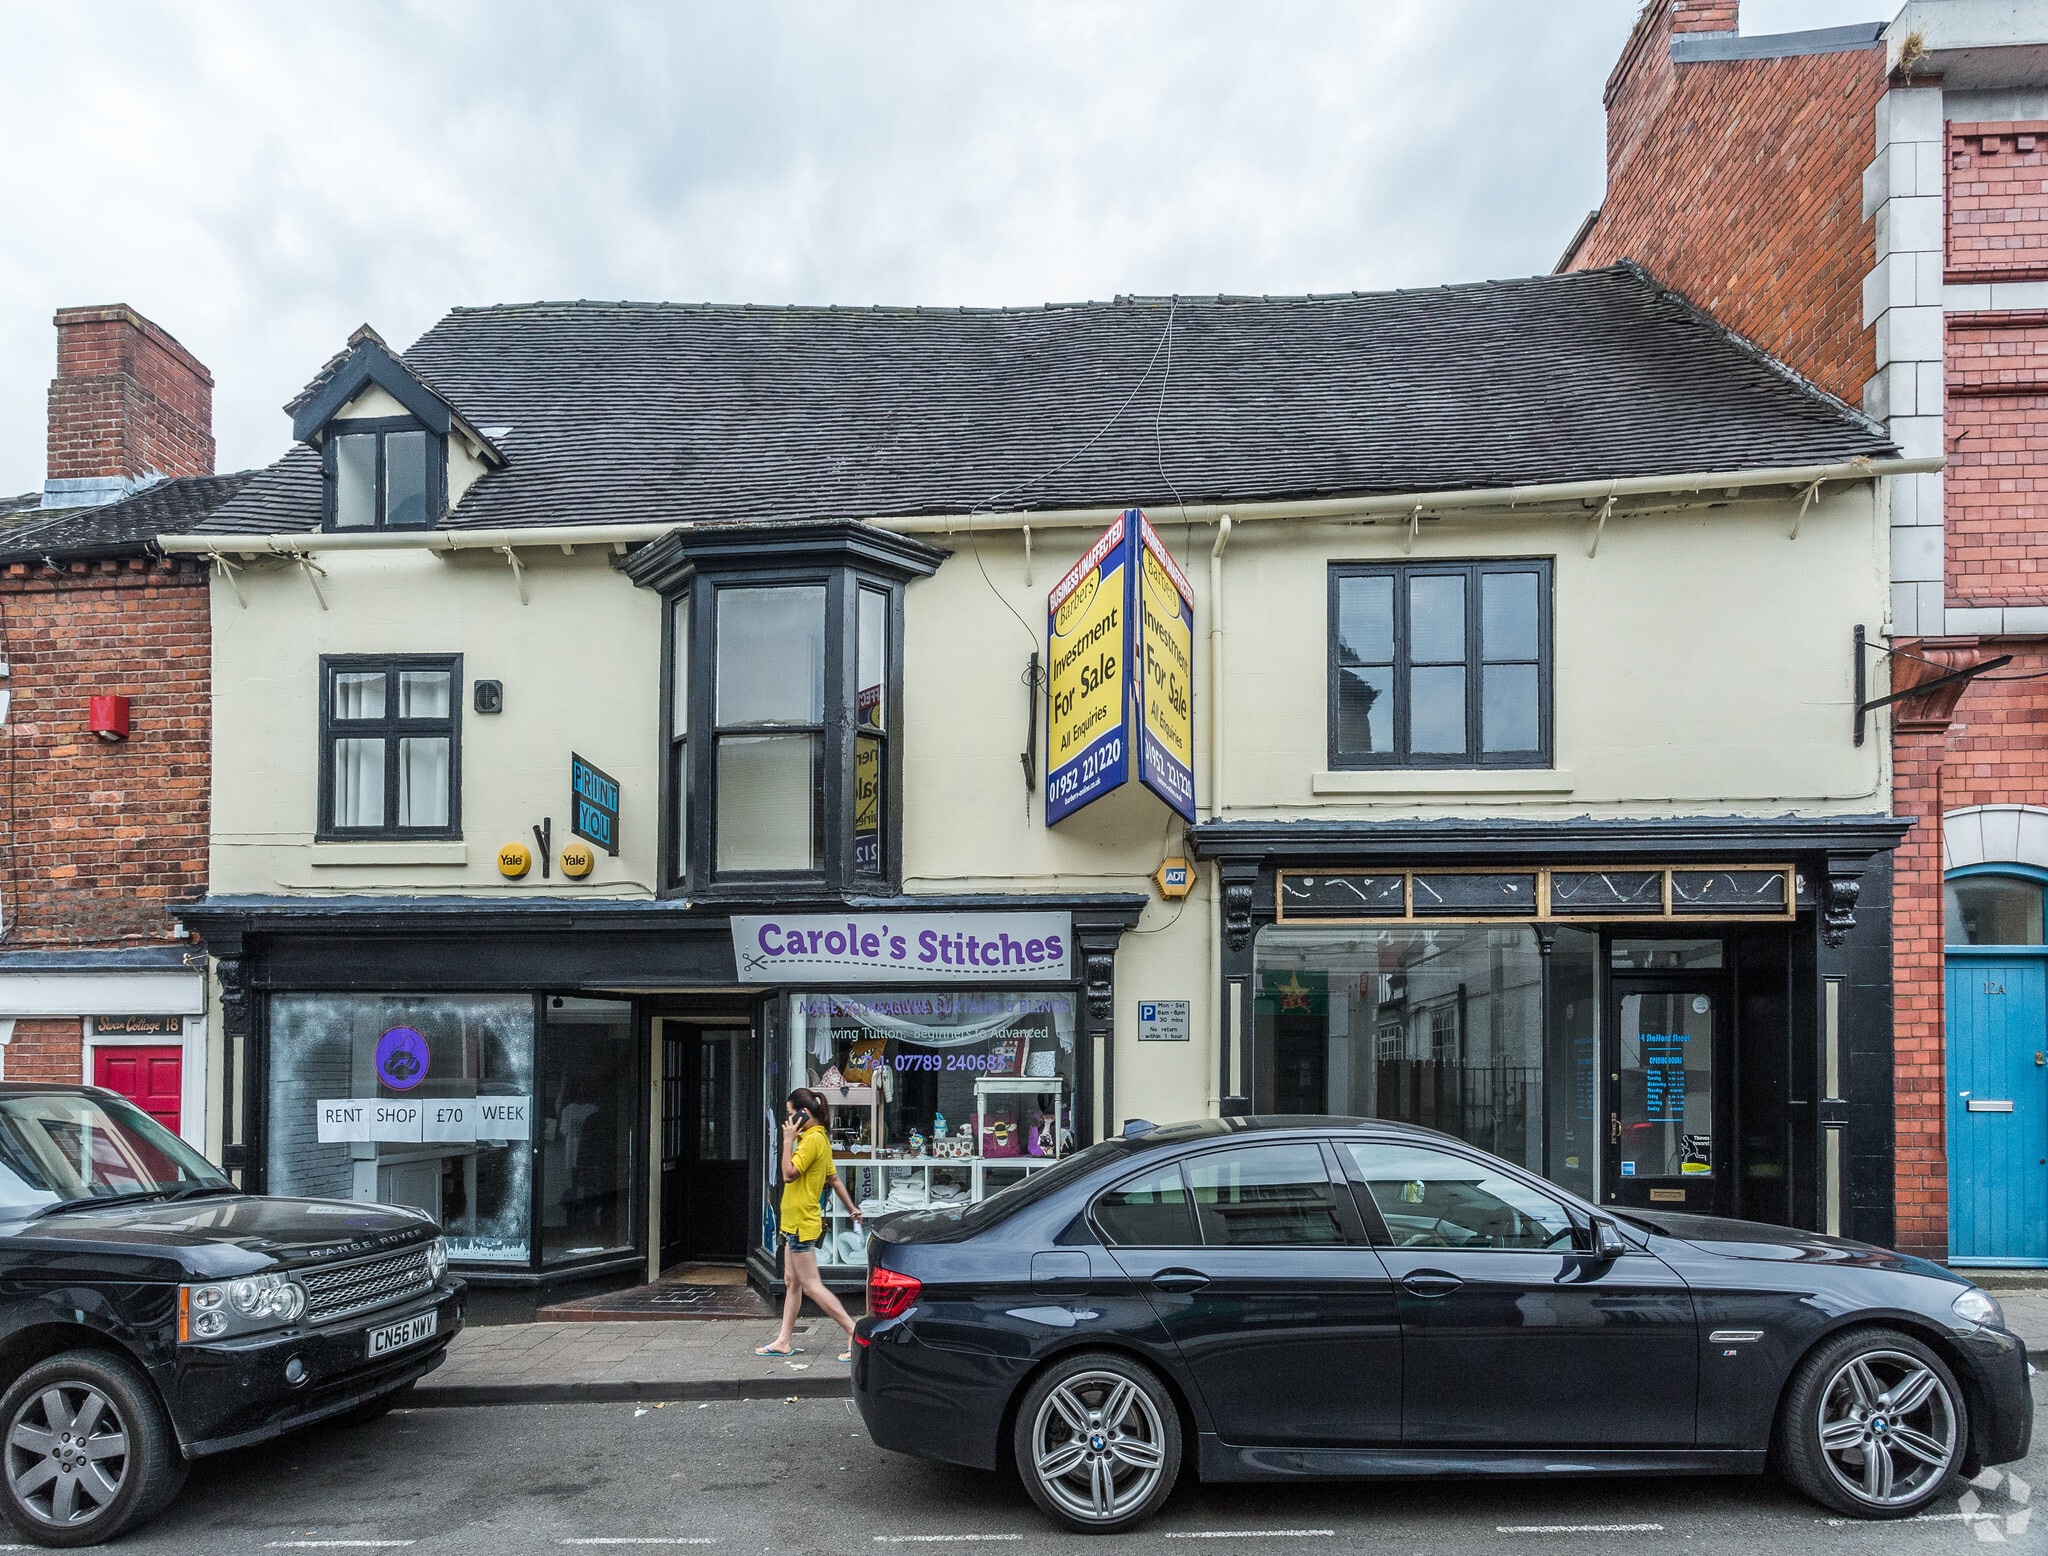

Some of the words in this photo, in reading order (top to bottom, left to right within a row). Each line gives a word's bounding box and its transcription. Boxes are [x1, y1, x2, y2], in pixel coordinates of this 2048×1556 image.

[1050, 566, 1079, 610] BUSINESS
[1079, 519, 1123, 580] UNAFFECTED
[1148, 553, 1177, 607] Barbers
[1060, 576, 1094, 626] Barbers
[1054, 605, 1117, 682] Investment
[1144, 600, 1188, 678] Investment
[1055, 687, 1075, 724] For
[1081, 653, 1116, 698] Sale
[1146, 642, 1166, 690] For
[1168, 672, 1187, 720] Sale
[1061, 730, 1071, 752] All
[1073, 705, 1107, 741] Enquiries
[1151, 700, 1159, 721] All
[1159, 712, 1183, 749] Enquiries
[576, 764, 617, 811] PRINT
[1050, 767, 1078, 802] 01952
[1082, 738, 1121, 783] 221220
[1167, 761, 1192, 801] 221220
[581, 803, 609, 841] YOU
[500, 855, 522, 865] Yale
[563, 855, 585, 865] Yale
[1166, 871, 1185, 881] ADT
[758, 923, 906, 960] Carole's
[918, 930, 1064, 966] Stitches
[98, 1016, 124, 1032] Swan
[126, 1016, 160, 1034] Cottage
[166, 1018, 179, 1031] 18
[818, 1027, 859, 1041] Sewing
[862, 1027, 906, 1039] Tuition:
[914, 1026, 971, 1041] Beginners
[975, 1028, 986, 1038] to
[991, 1026, 1049, 1039] Advanced
[1647, 1033, 1671, 1042] Stafford
[1673, 1033, 1691, 1042] Street
[861, 1055, 889, 1071] Tel:
[895, 1055, 942, 1072] 07789
[326, 1109, 363, 1123] RENT
[377, 1108, 417, 1123] SHOP
[436, 1108, 463, 1123] £70
[482, 1105, 524, 1121] WEEK
[309, 1241, 374, 1258] RANGE
[380, 1229, 422, 1245] ROVER
[375, 1323, 409, 1351] CN56
[412, 1314, 434, 1339] NWV
